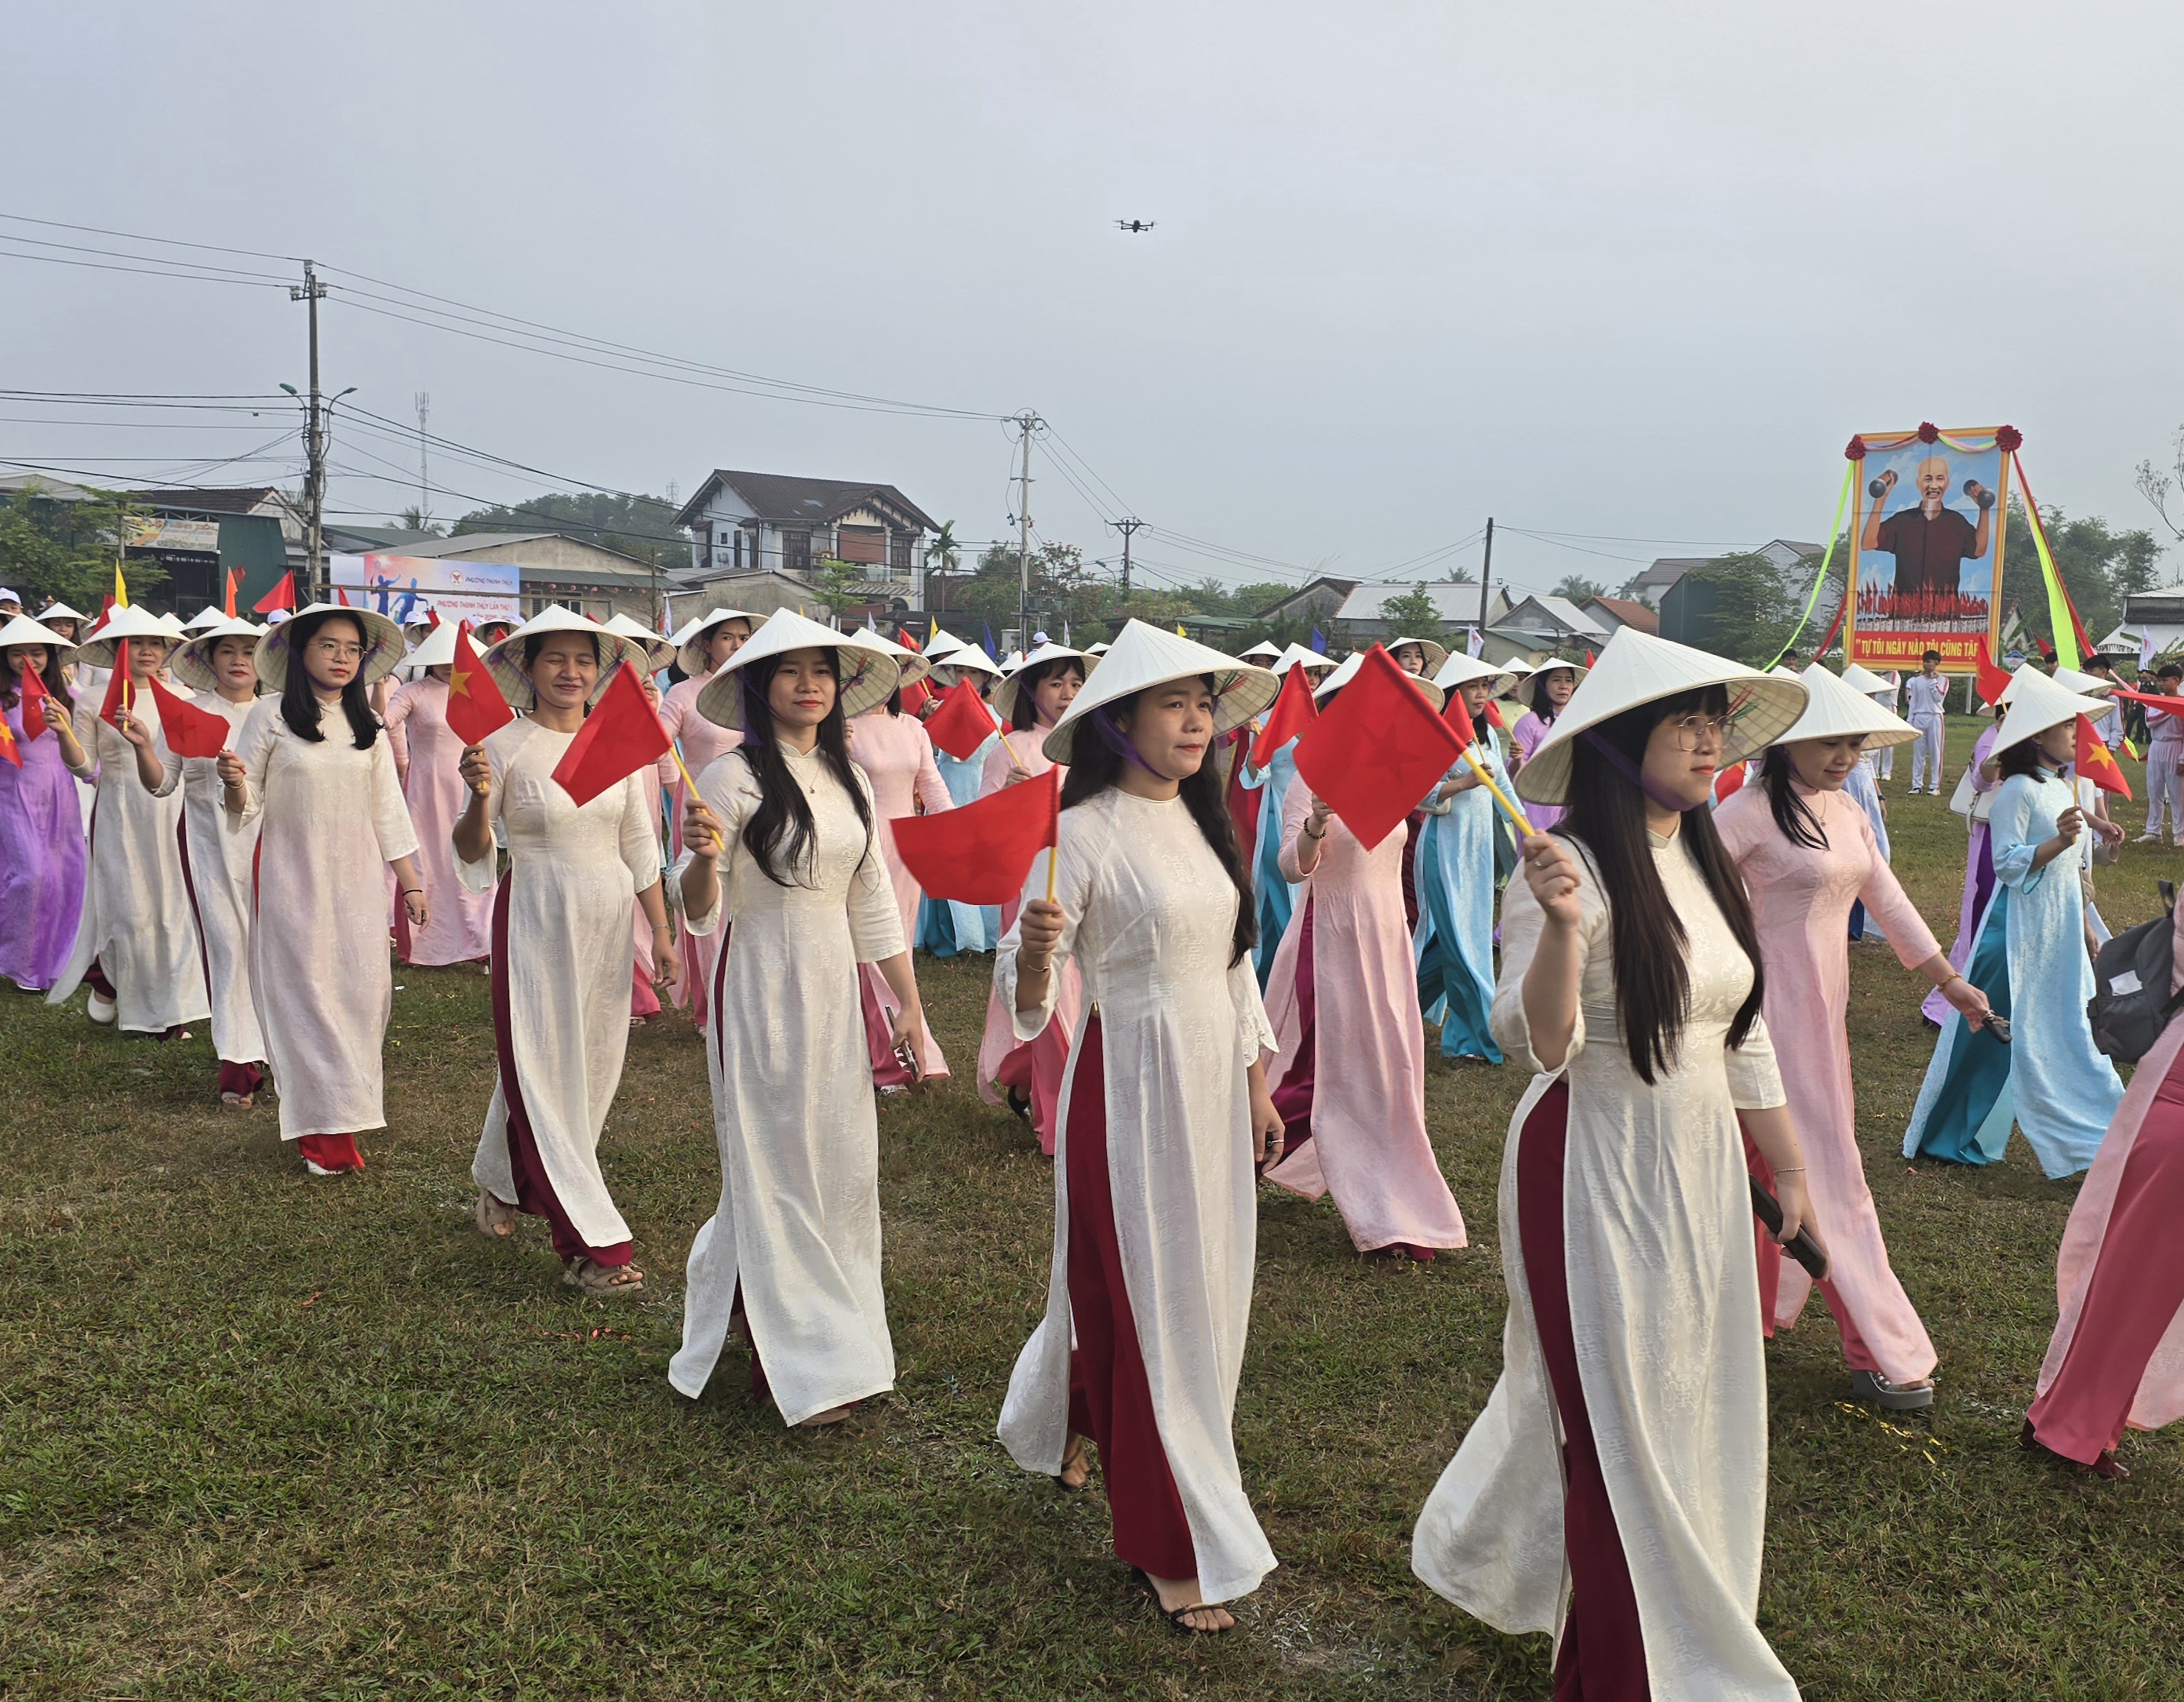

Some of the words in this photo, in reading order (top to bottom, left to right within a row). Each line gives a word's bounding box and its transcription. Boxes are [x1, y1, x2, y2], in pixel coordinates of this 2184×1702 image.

[1873, 638, 1884, 655] TÔI
[1886, 638, 1907, 656] NGÀY
[1908, 638, 1924, 656] NÀO
[1940, 639, 1962, 656] CŨNG
